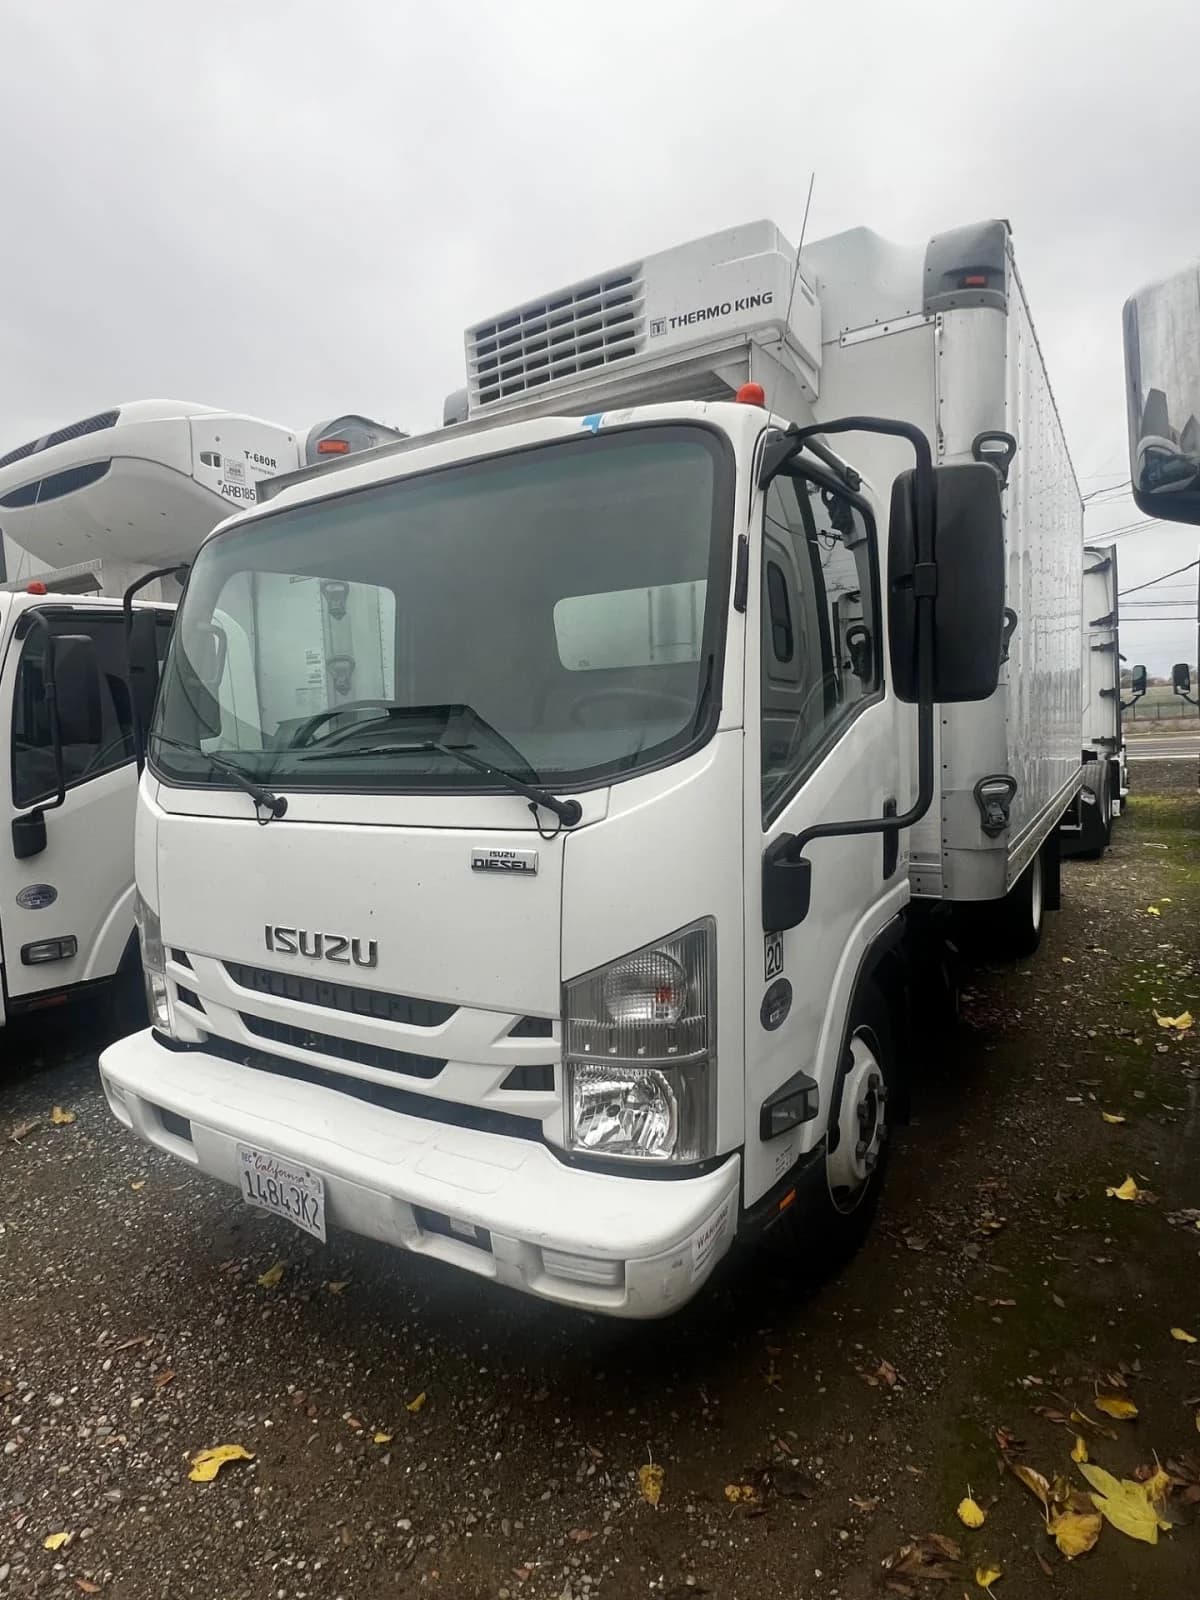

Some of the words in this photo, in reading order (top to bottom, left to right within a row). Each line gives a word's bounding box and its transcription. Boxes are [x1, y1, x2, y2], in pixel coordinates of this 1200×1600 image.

[669, 302, 731, 329] THERMO
[735, 292, 773, 312] KING
[244, 450, 277, 469] T-680R
[472, 858, 535, 874] DIESEL
[489, 850, 516, 858] ISUZU
[264, 924, 378, 968] ISUZU
[767, 941, 781, 976] 20
[255, 1157, 305, 1186] California
[244, 1170, 321, 1232] 14843K2
